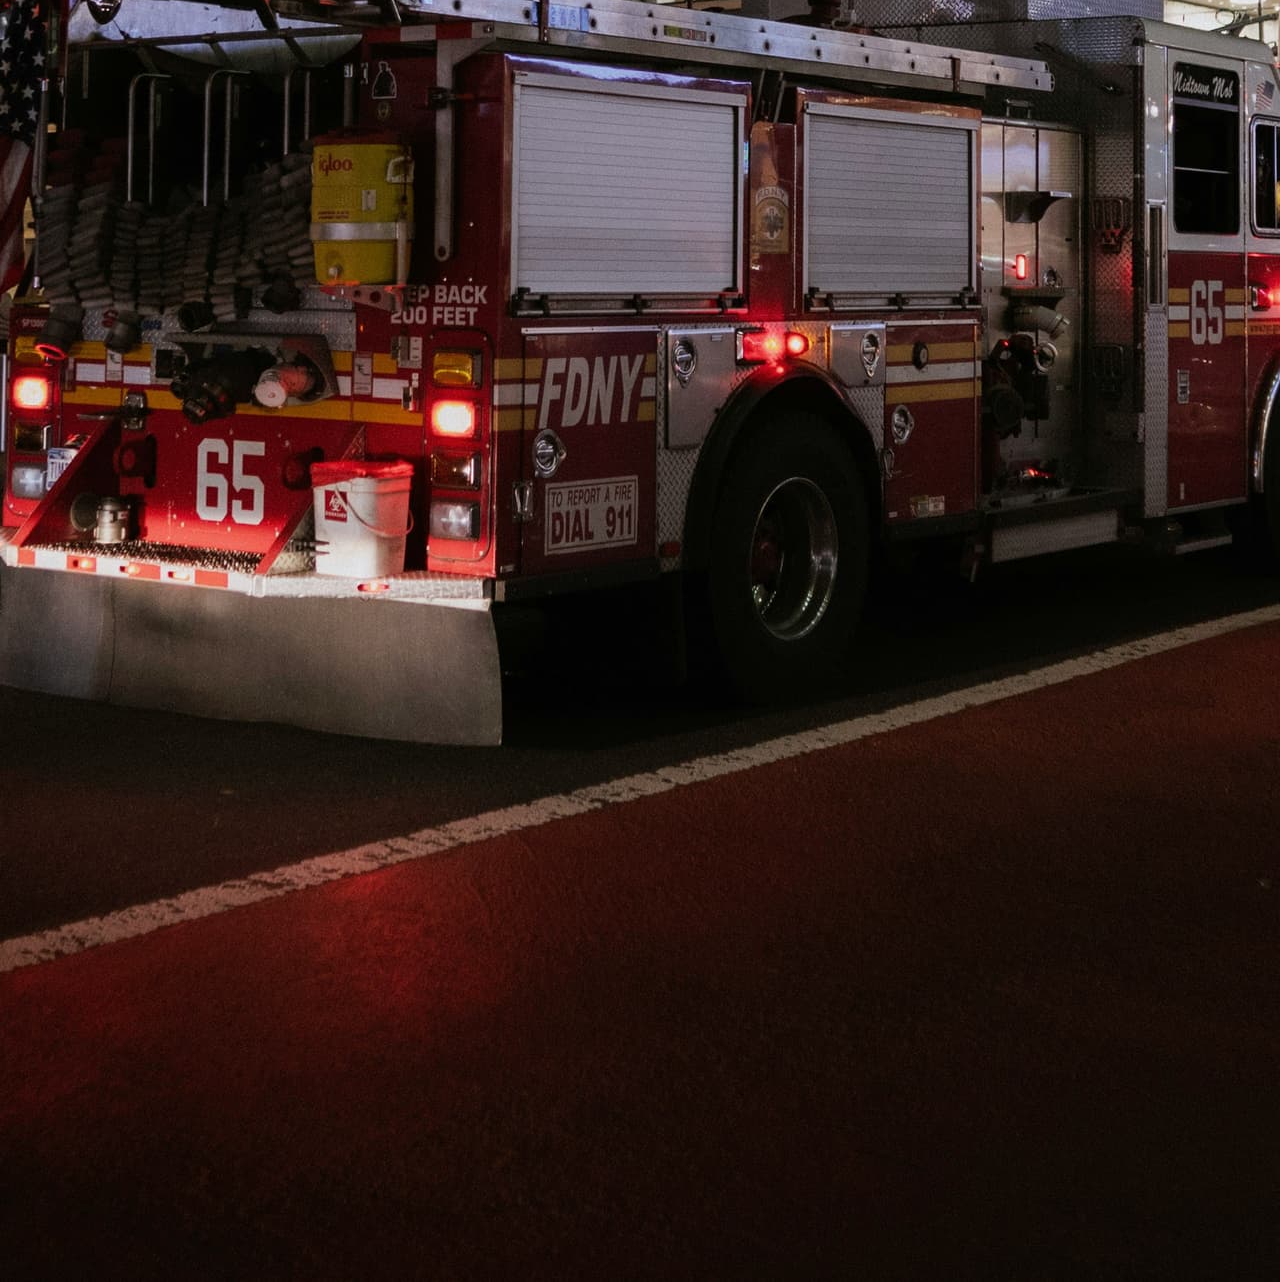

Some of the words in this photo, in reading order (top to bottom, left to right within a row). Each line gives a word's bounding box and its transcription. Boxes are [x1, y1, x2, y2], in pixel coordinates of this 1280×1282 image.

[407, 283, 430, 303] EP
[434, 284, 488, 305] BACK
[1191, 280, 1223, 345] 65
[390, 305, 428, 325] 200
[432, 306, 479, 326] FEET
[537, 354, 645, 430] FDNY
[196, 437, 266, 526] 65
[551, 491, 562, 508] TO
[567, 487, 601, 505] REPORT
[604, 486, 610, 503] A
[614, 484, 632, 501] FIRE
[551, 508, 594, 544] DIAL
[606, 504, 632, 538] 911
